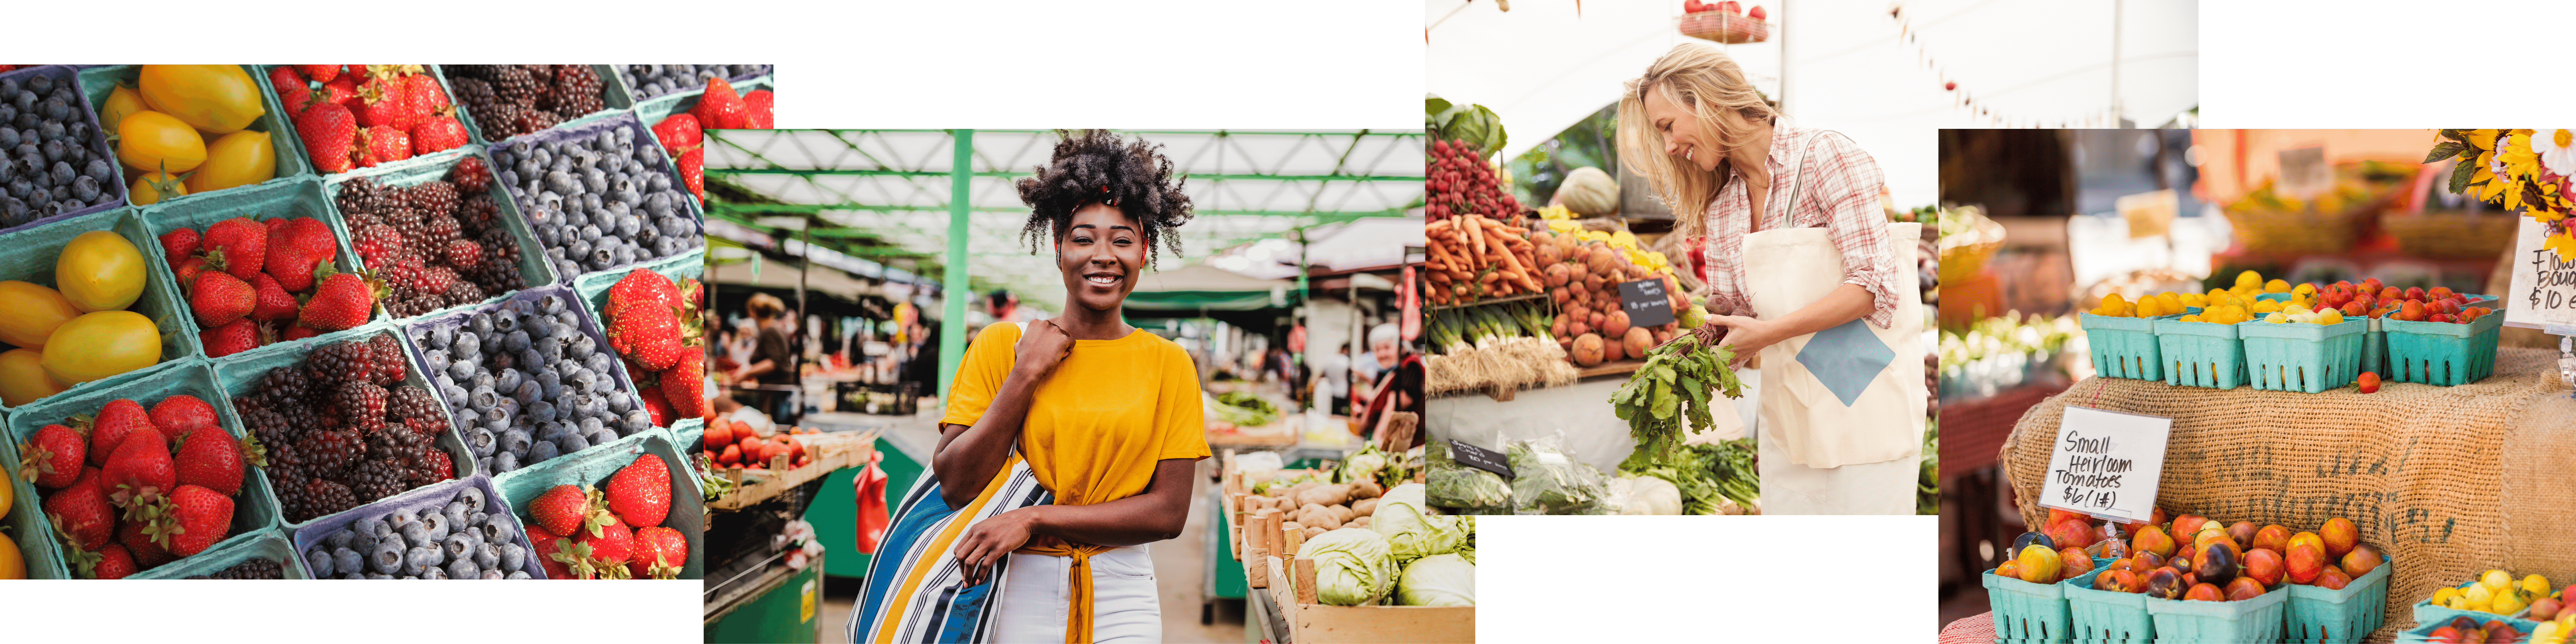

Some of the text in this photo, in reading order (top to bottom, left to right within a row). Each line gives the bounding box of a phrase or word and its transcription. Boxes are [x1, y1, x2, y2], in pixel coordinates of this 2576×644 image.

[2532, 249, 2576, 272] Flow
[1640, 302, 1649, 311] per
[2065, 430, 2110, 454] Small
[2069, 455, 2132, 473] Heirloom
[2056, 470, 2122, 489] Tomatoes
